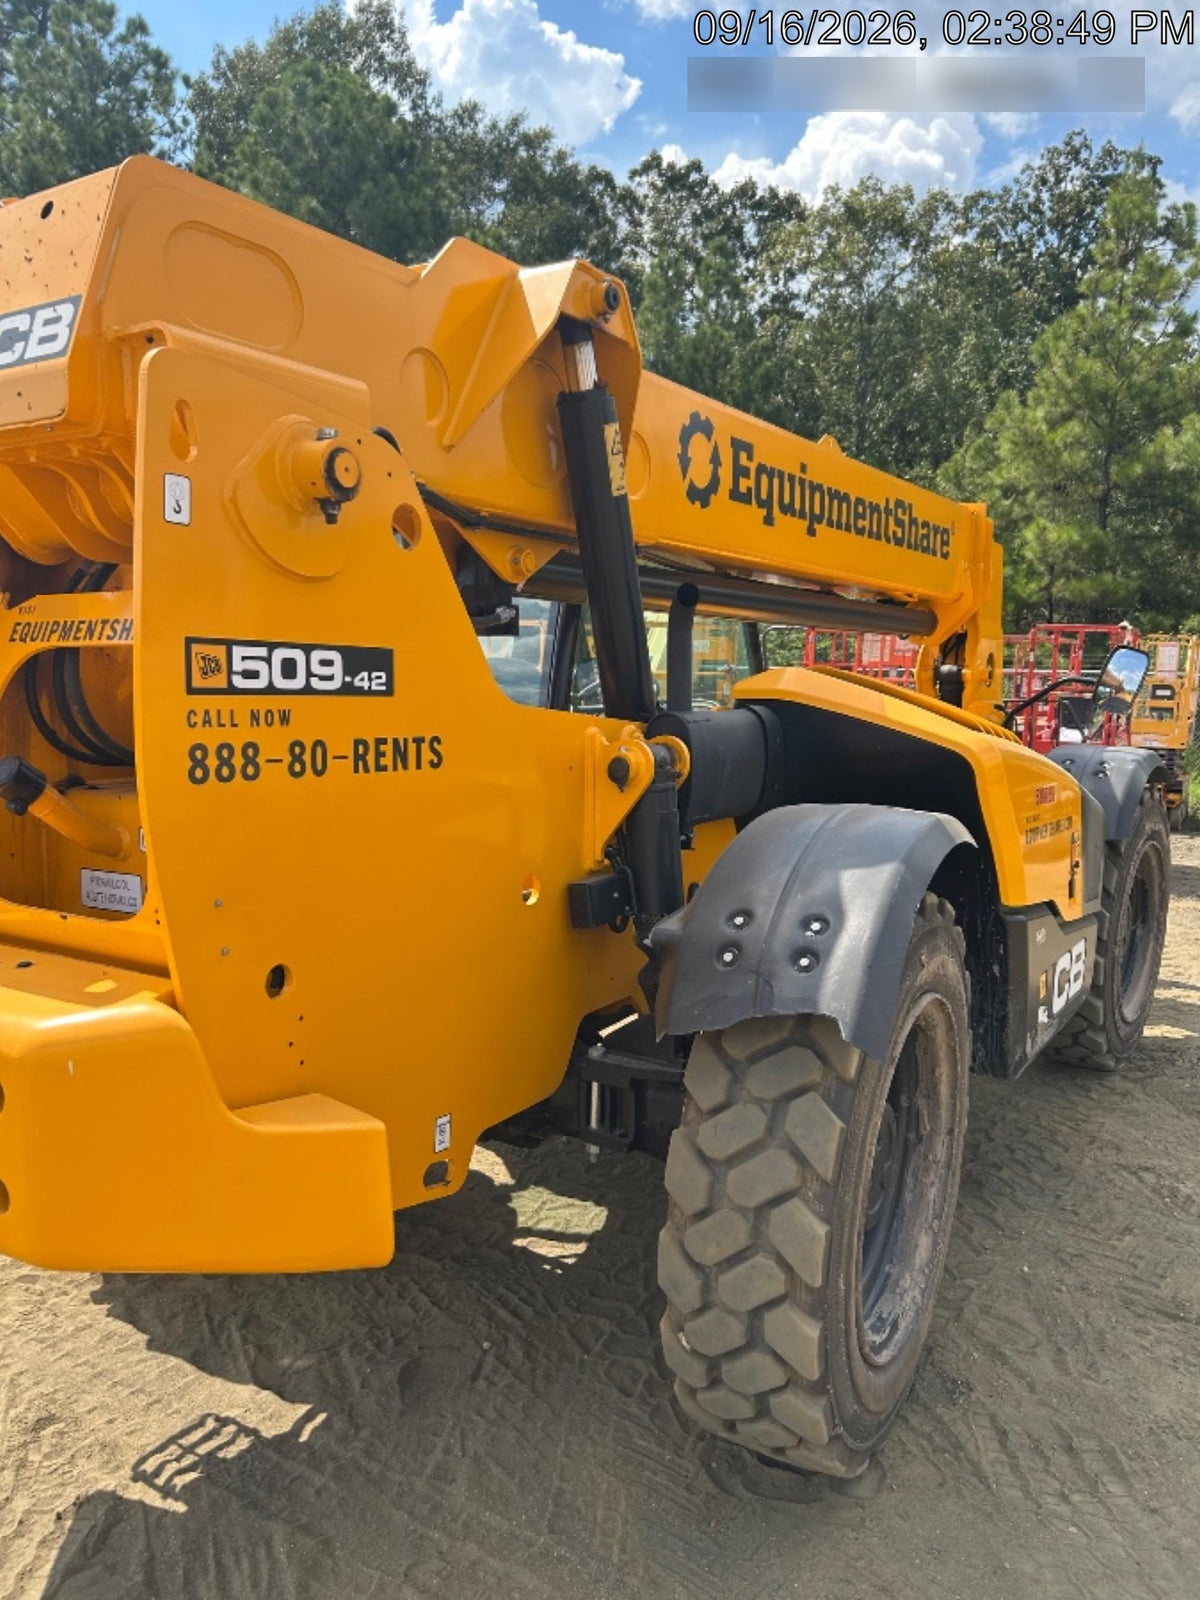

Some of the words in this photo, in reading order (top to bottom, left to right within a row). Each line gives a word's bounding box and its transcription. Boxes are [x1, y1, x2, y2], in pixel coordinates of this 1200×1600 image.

[729, 436, 951, 560] EquipmentShare
[8, 618, 134, 644] EQUIPMENTSH
[231, 645, 387, 691] 509-42
[186, 709, 239, 729] CALL
[250, 709, 292, 728] NOW
[187, 735, 443, 786] 888-80-RENTS
